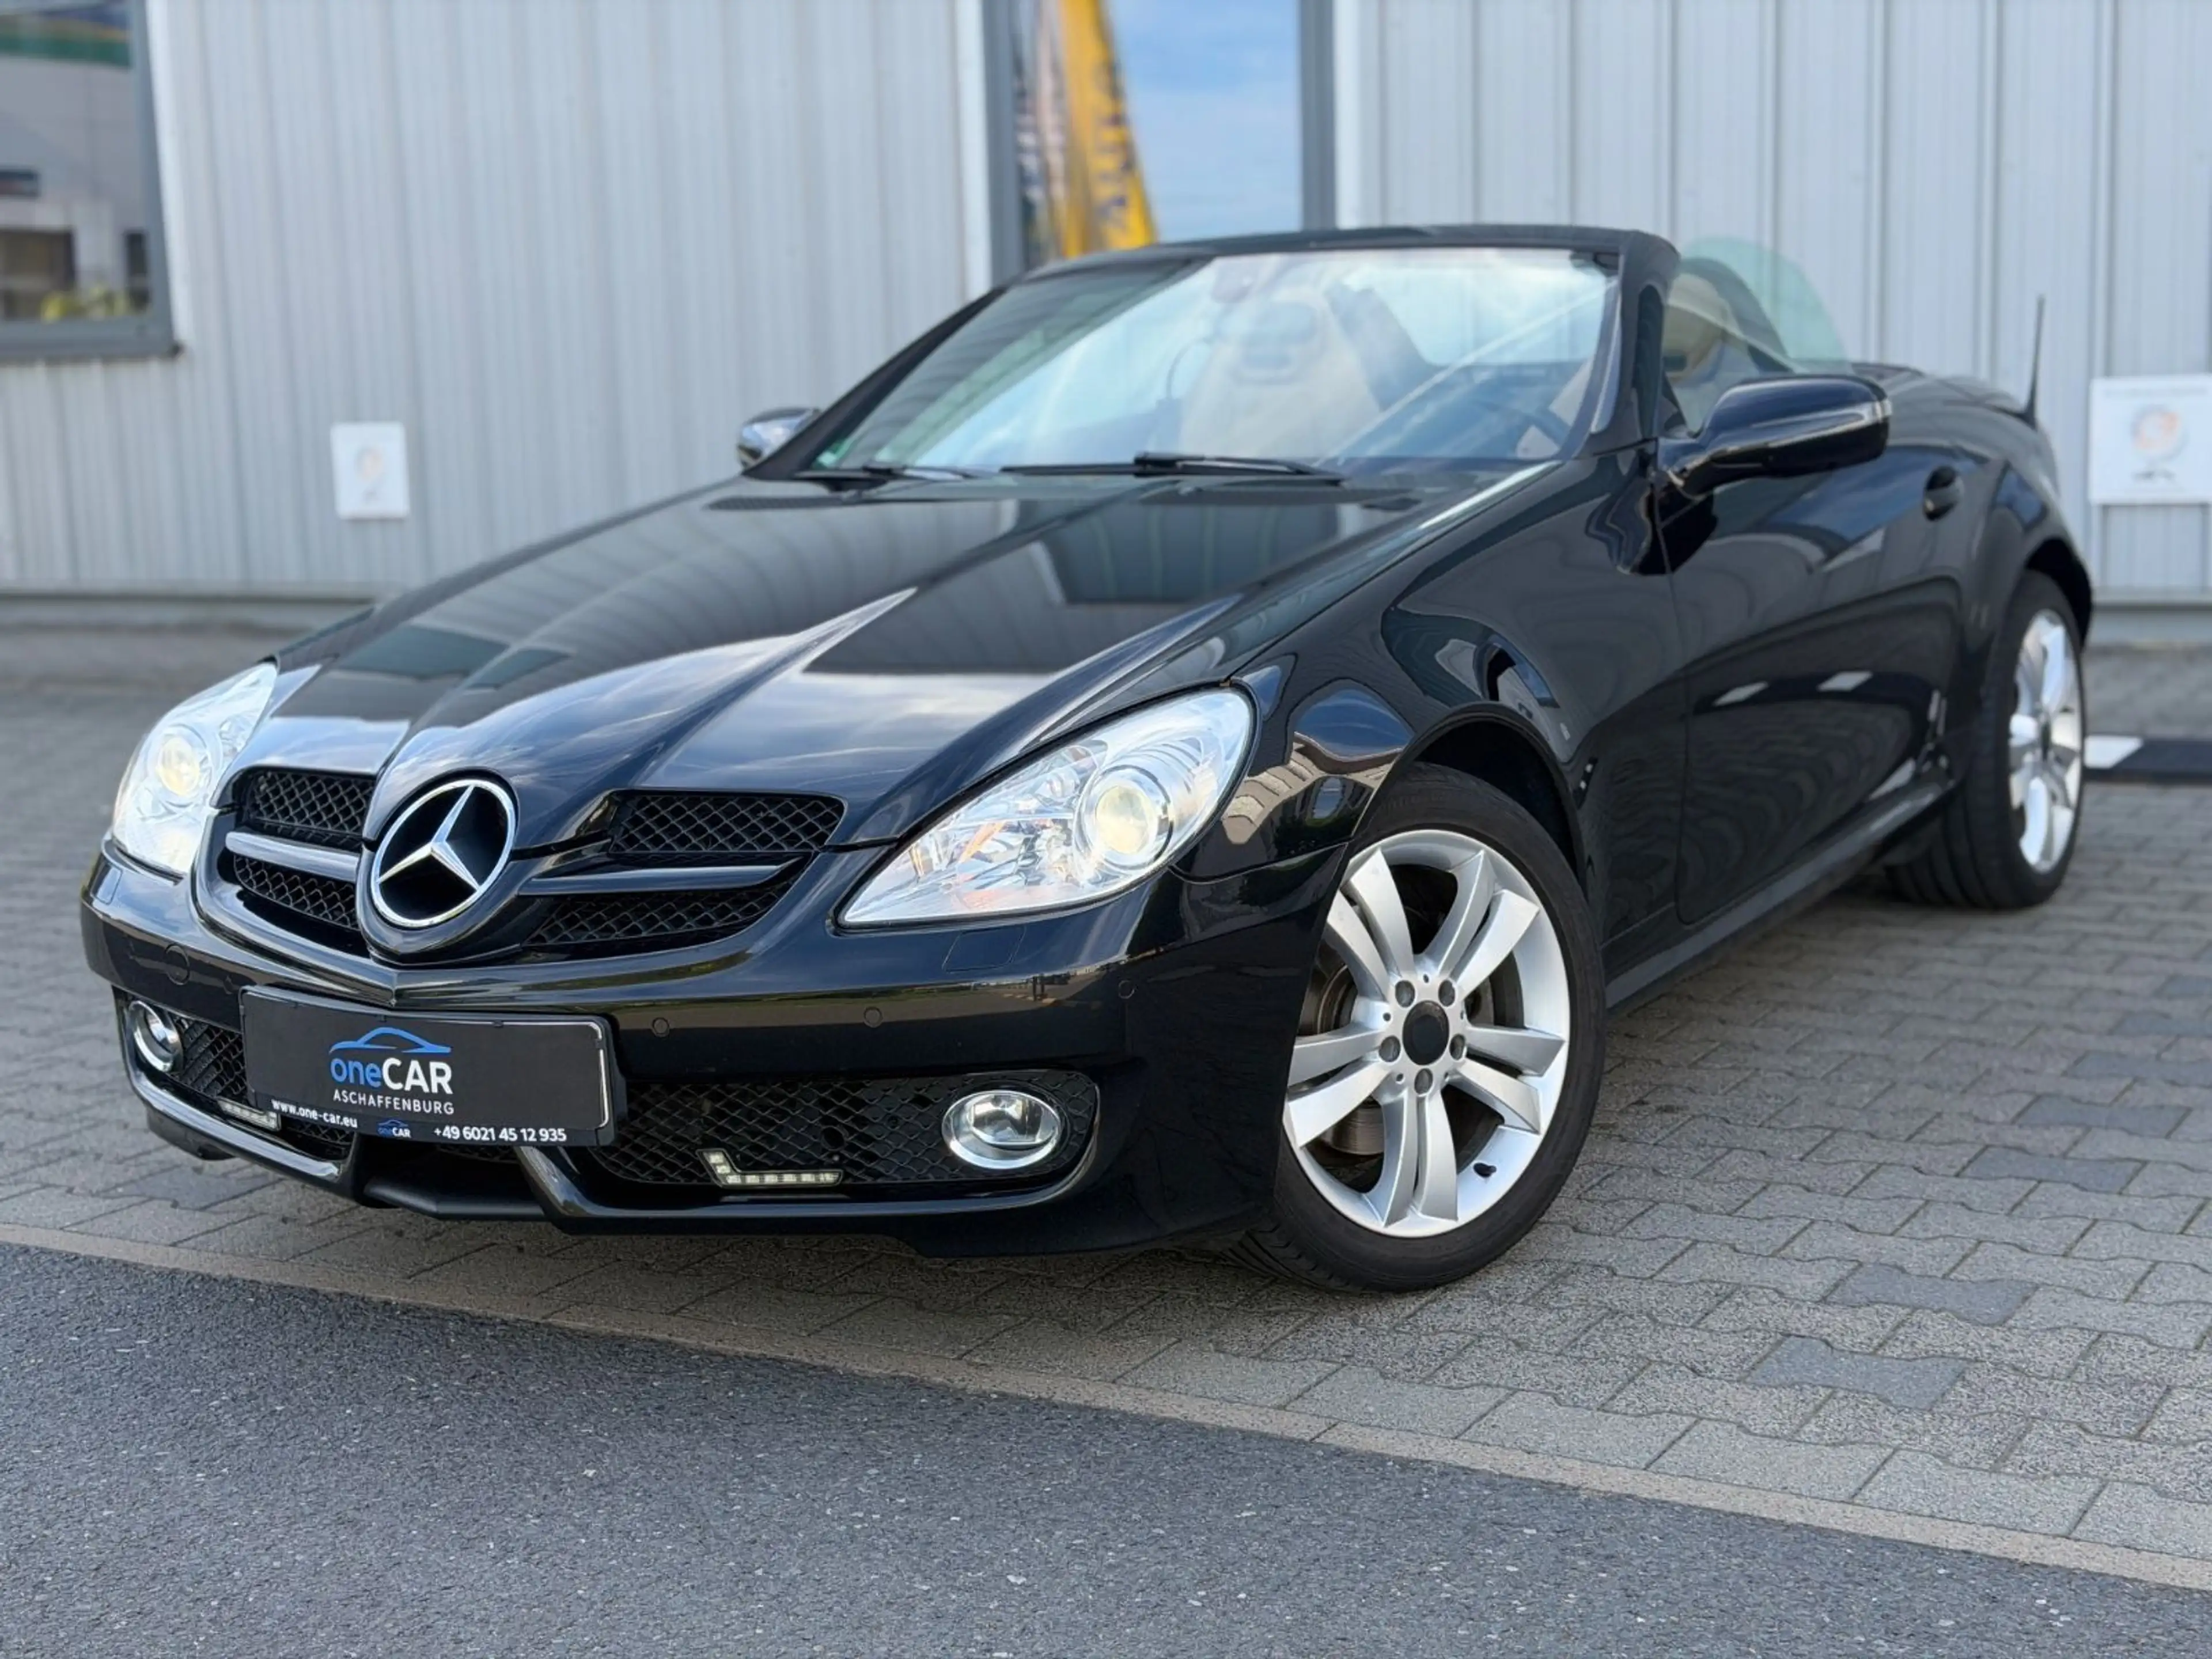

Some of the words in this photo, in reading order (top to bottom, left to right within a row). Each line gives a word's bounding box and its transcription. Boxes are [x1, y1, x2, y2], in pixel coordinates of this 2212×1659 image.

[330, 1057, 453, 1094] oneCAR
[271, 1099, 358, 1129] www.one-car.eu
[333, 1089, 454, 1115] ASCHAFFENBURG
[434, 1125, 460, 1140] +49
[462, 1126, 496, 1141] 6021
[498, 1127, 518, 1142] 45
[520, 1128, 537, 1142] 12
[539, 1128, 567, 1142] 935
